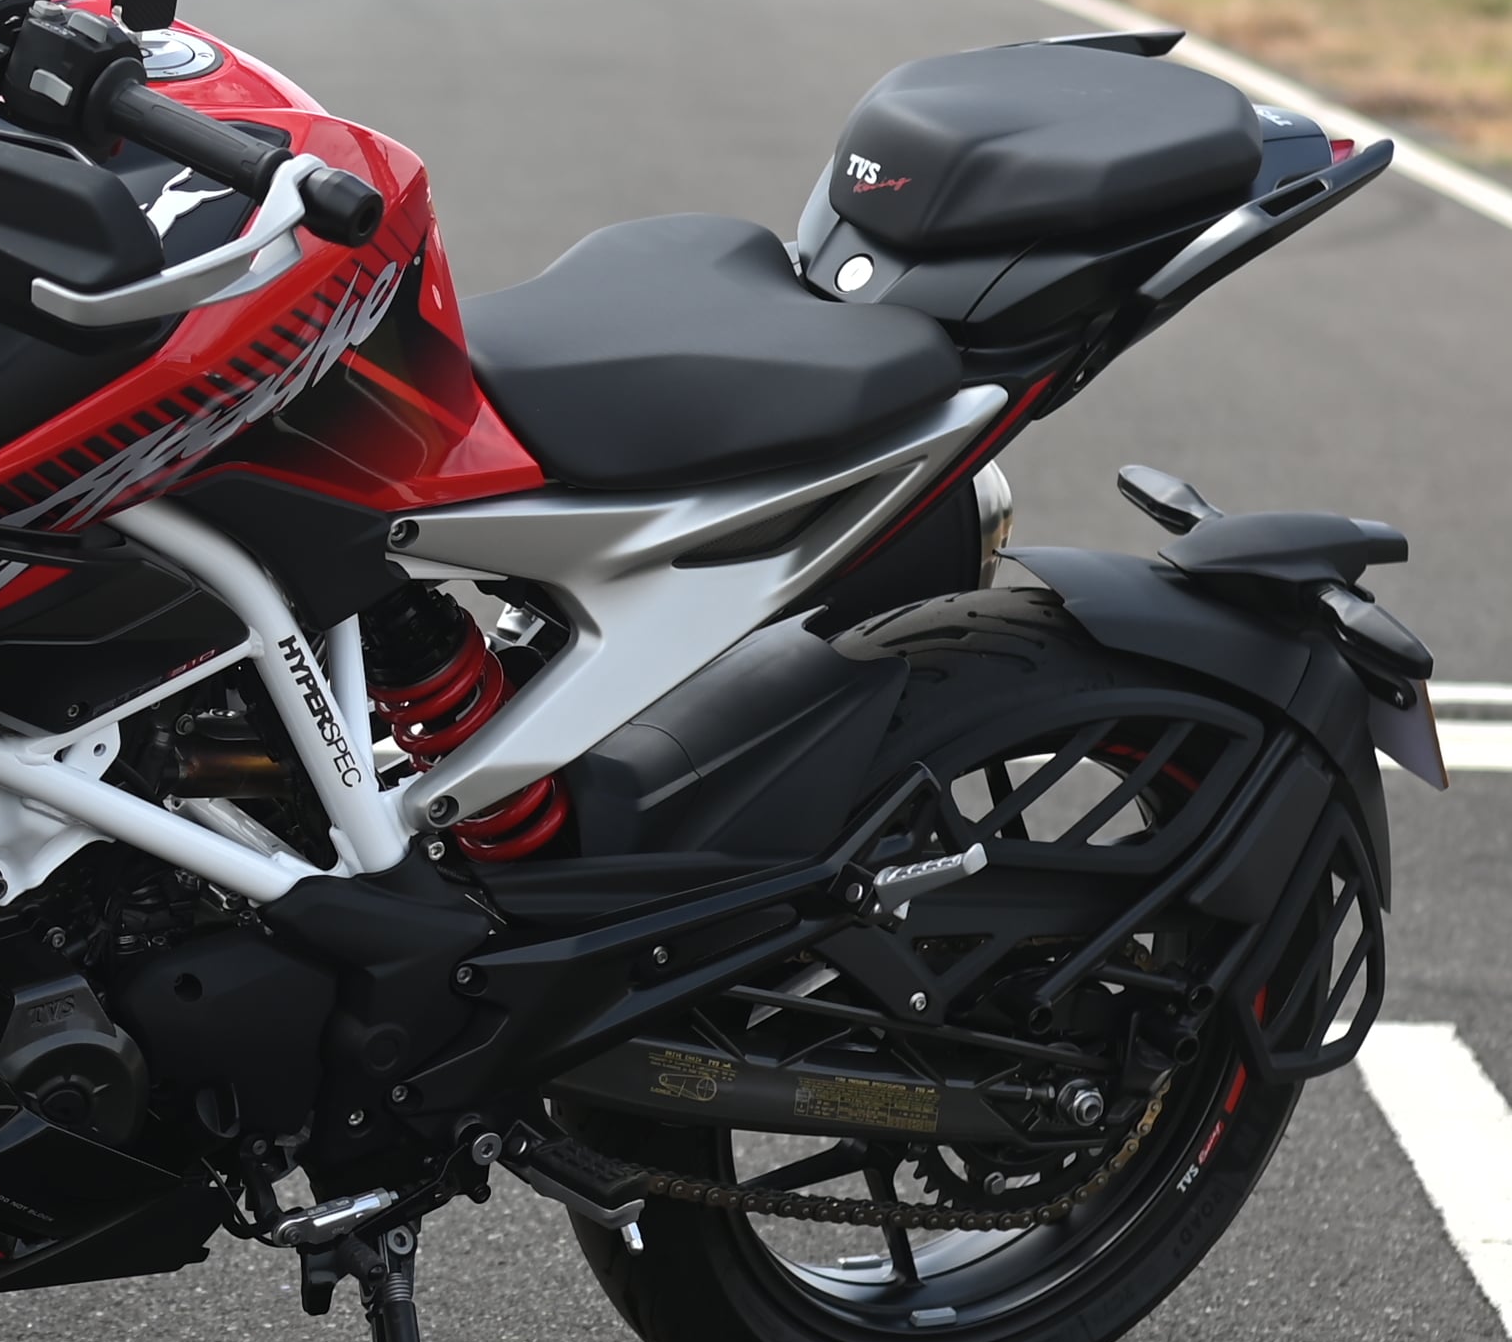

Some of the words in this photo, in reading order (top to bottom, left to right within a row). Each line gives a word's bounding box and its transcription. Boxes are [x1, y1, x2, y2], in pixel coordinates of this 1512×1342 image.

[846, 153, 881, 185] TVS
[277, 634, 362, 789] HYPERSPEC
[28, 994, 75, 1027] TVS
[1176, 1163, 1200, 1193] TVS
